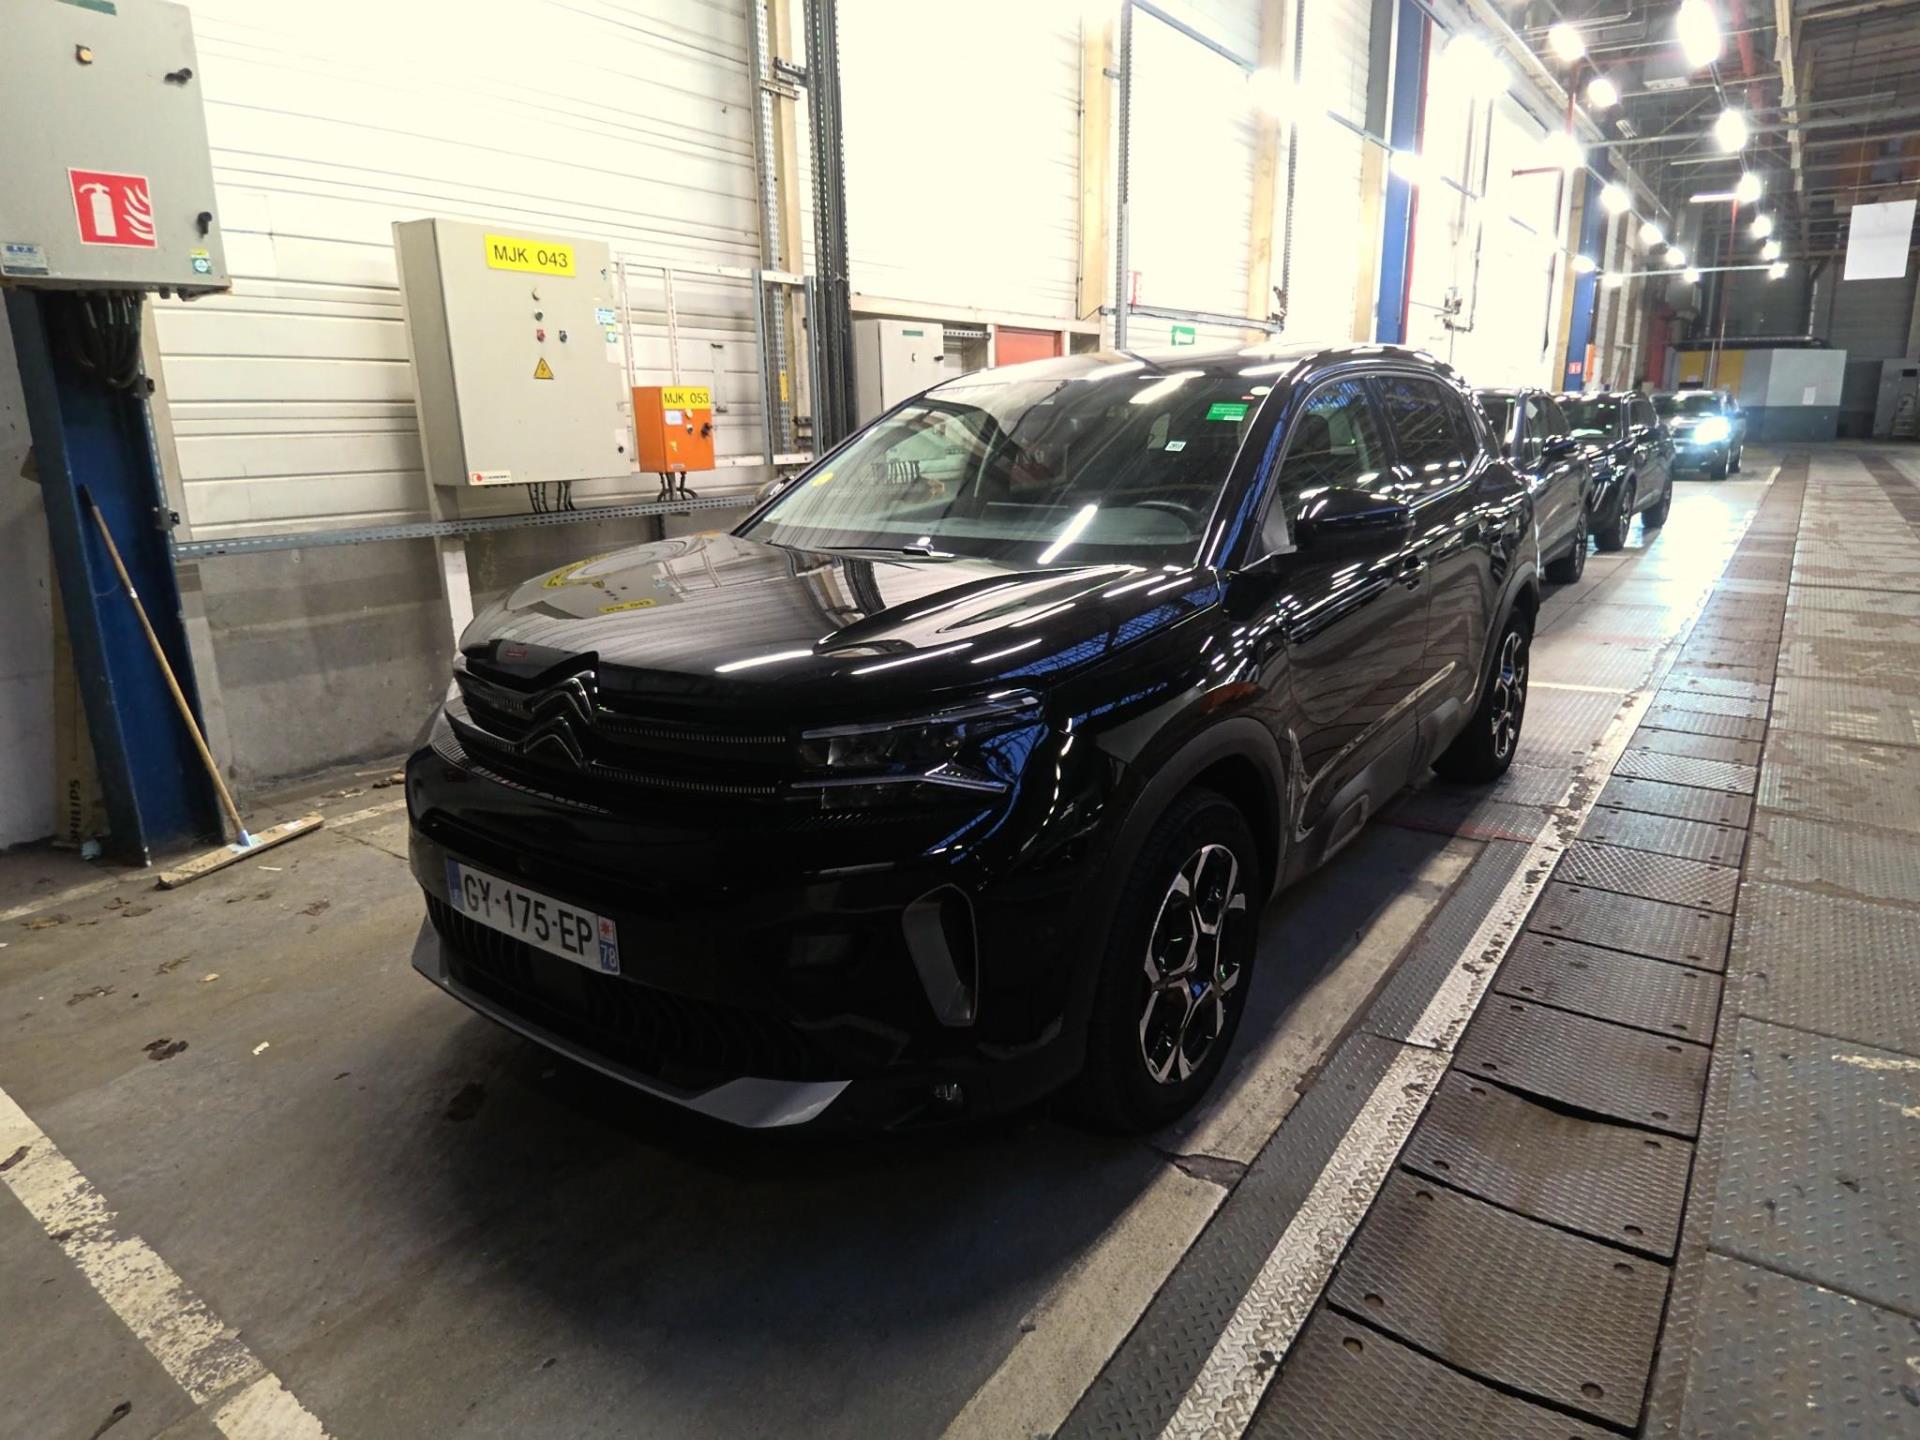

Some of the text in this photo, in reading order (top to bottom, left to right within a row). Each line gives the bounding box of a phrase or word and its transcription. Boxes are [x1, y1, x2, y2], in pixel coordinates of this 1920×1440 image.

[494, 244, 568, 268] MJK 043
[664, 392, 709, 404] MJK 053
[464, 873, 592, 956] GY-175-EP
[601, 943, 618, 968] 78
